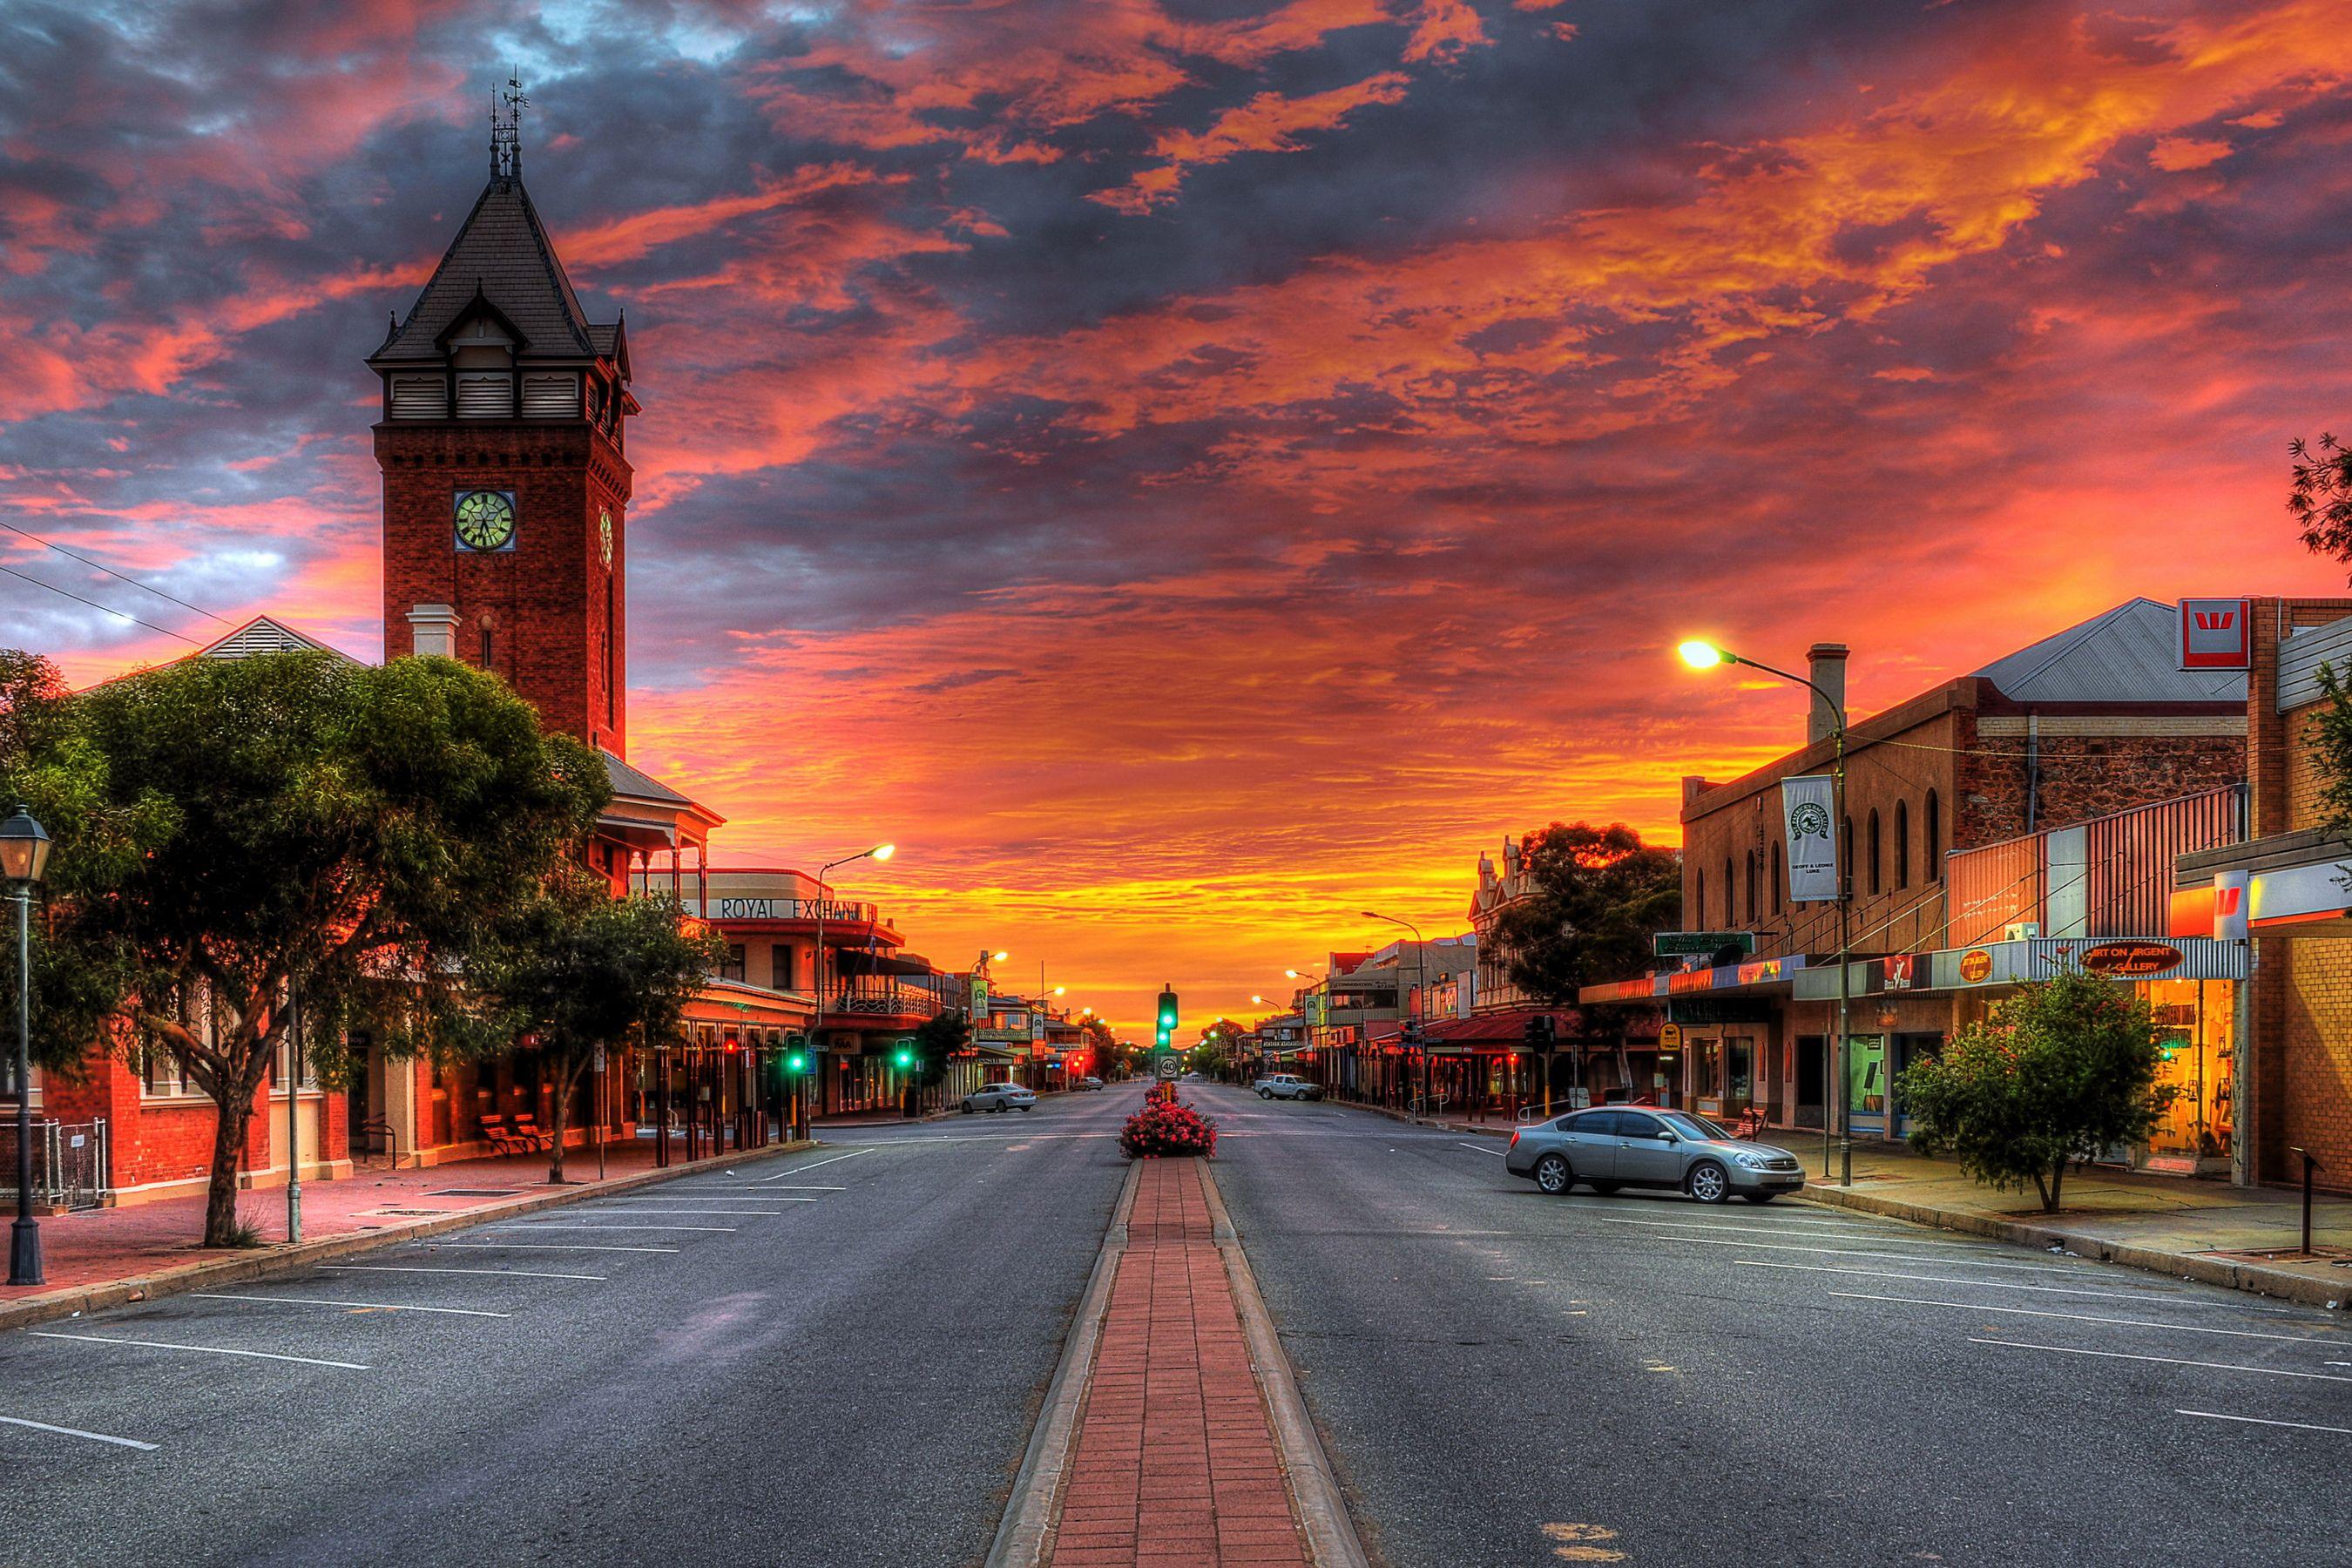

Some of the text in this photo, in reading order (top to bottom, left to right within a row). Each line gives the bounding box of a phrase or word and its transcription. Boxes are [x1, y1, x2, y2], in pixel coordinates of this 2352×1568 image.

[722, 899, 778, 919] ROYAL
[2111, 948, 2127, 956] ON
[2129, 947, 2171, 957] ARGENT
[2116, 962, 2160, 972] GALLERY
